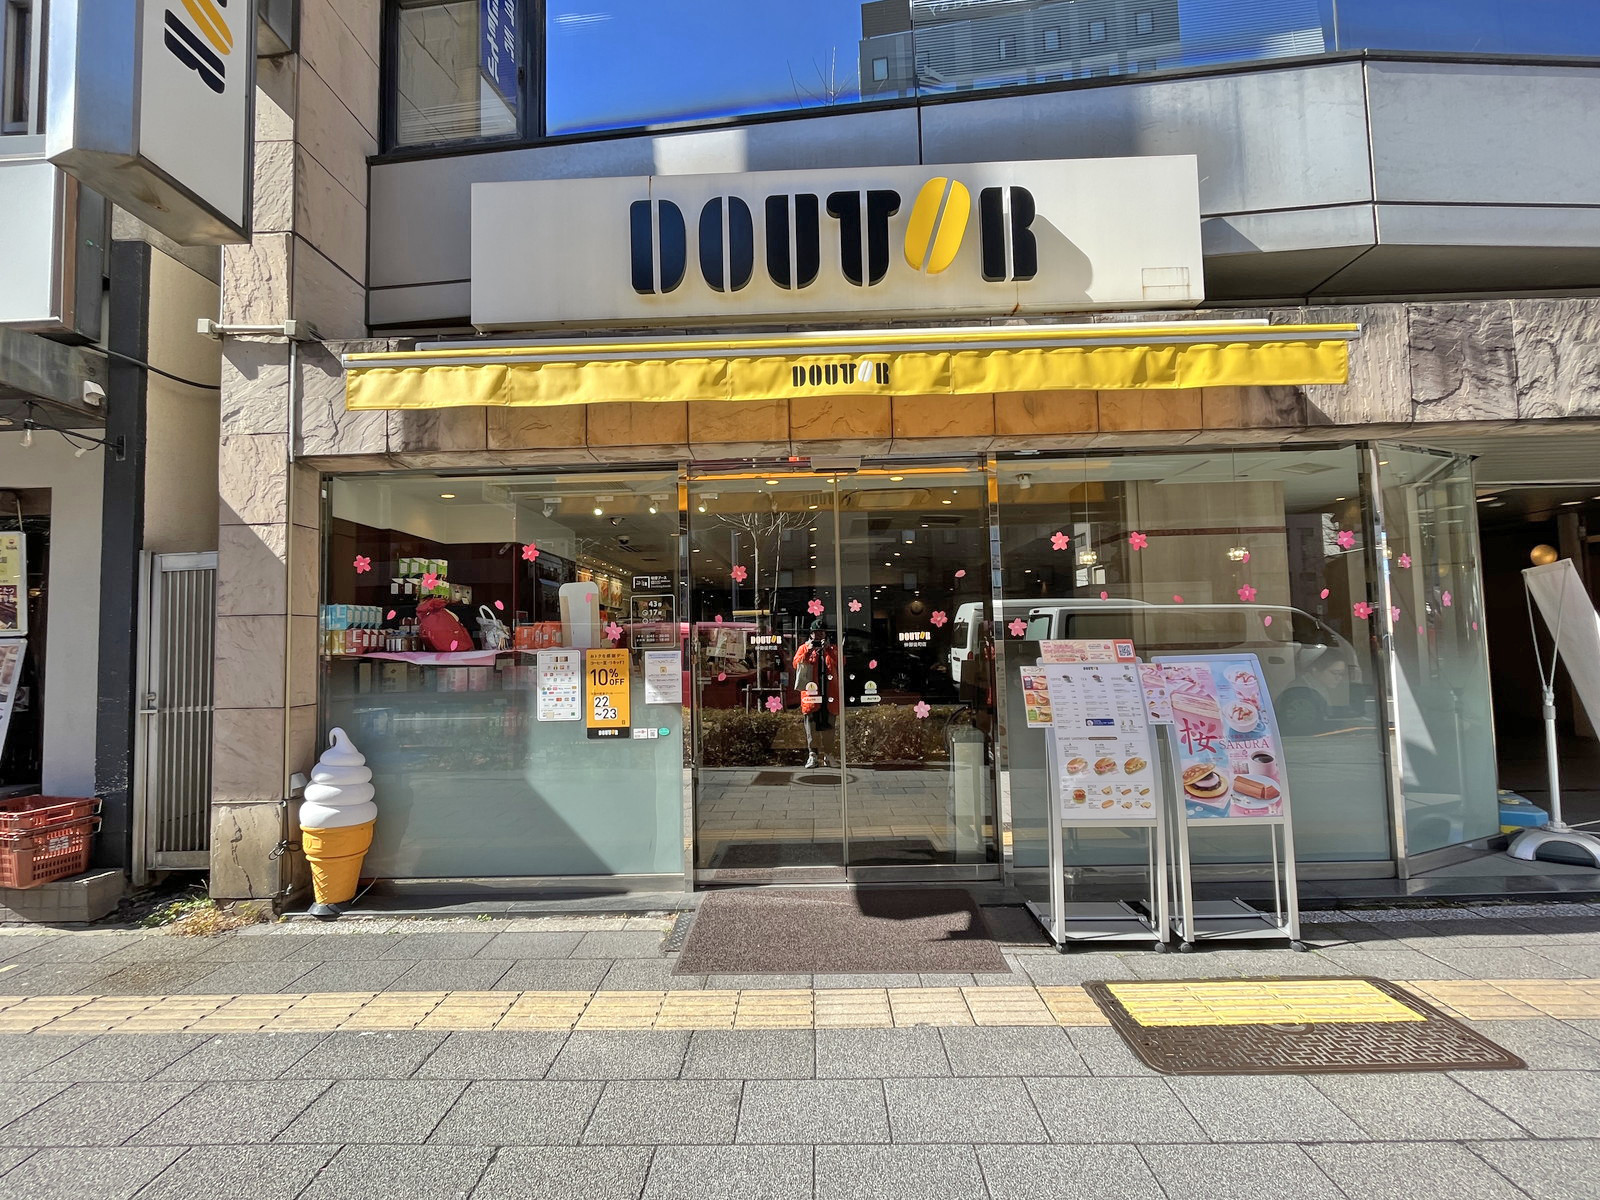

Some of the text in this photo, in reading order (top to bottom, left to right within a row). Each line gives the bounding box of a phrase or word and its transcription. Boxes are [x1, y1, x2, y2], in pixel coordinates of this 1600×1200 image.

[630, 177, 1037, 294] DOUTOR
[792, 360, 890, 387] DOUTOR
[750, 634, 782, 645] DOUTOR
[898, 630, 931, 641] DOUTOR
[609, 678, 625, 686] OFF
[594, 696, 609, 708] 22
[1179, 717, 1217, 755] 桜
[1218, 738, 1270, 750] SAKURA
